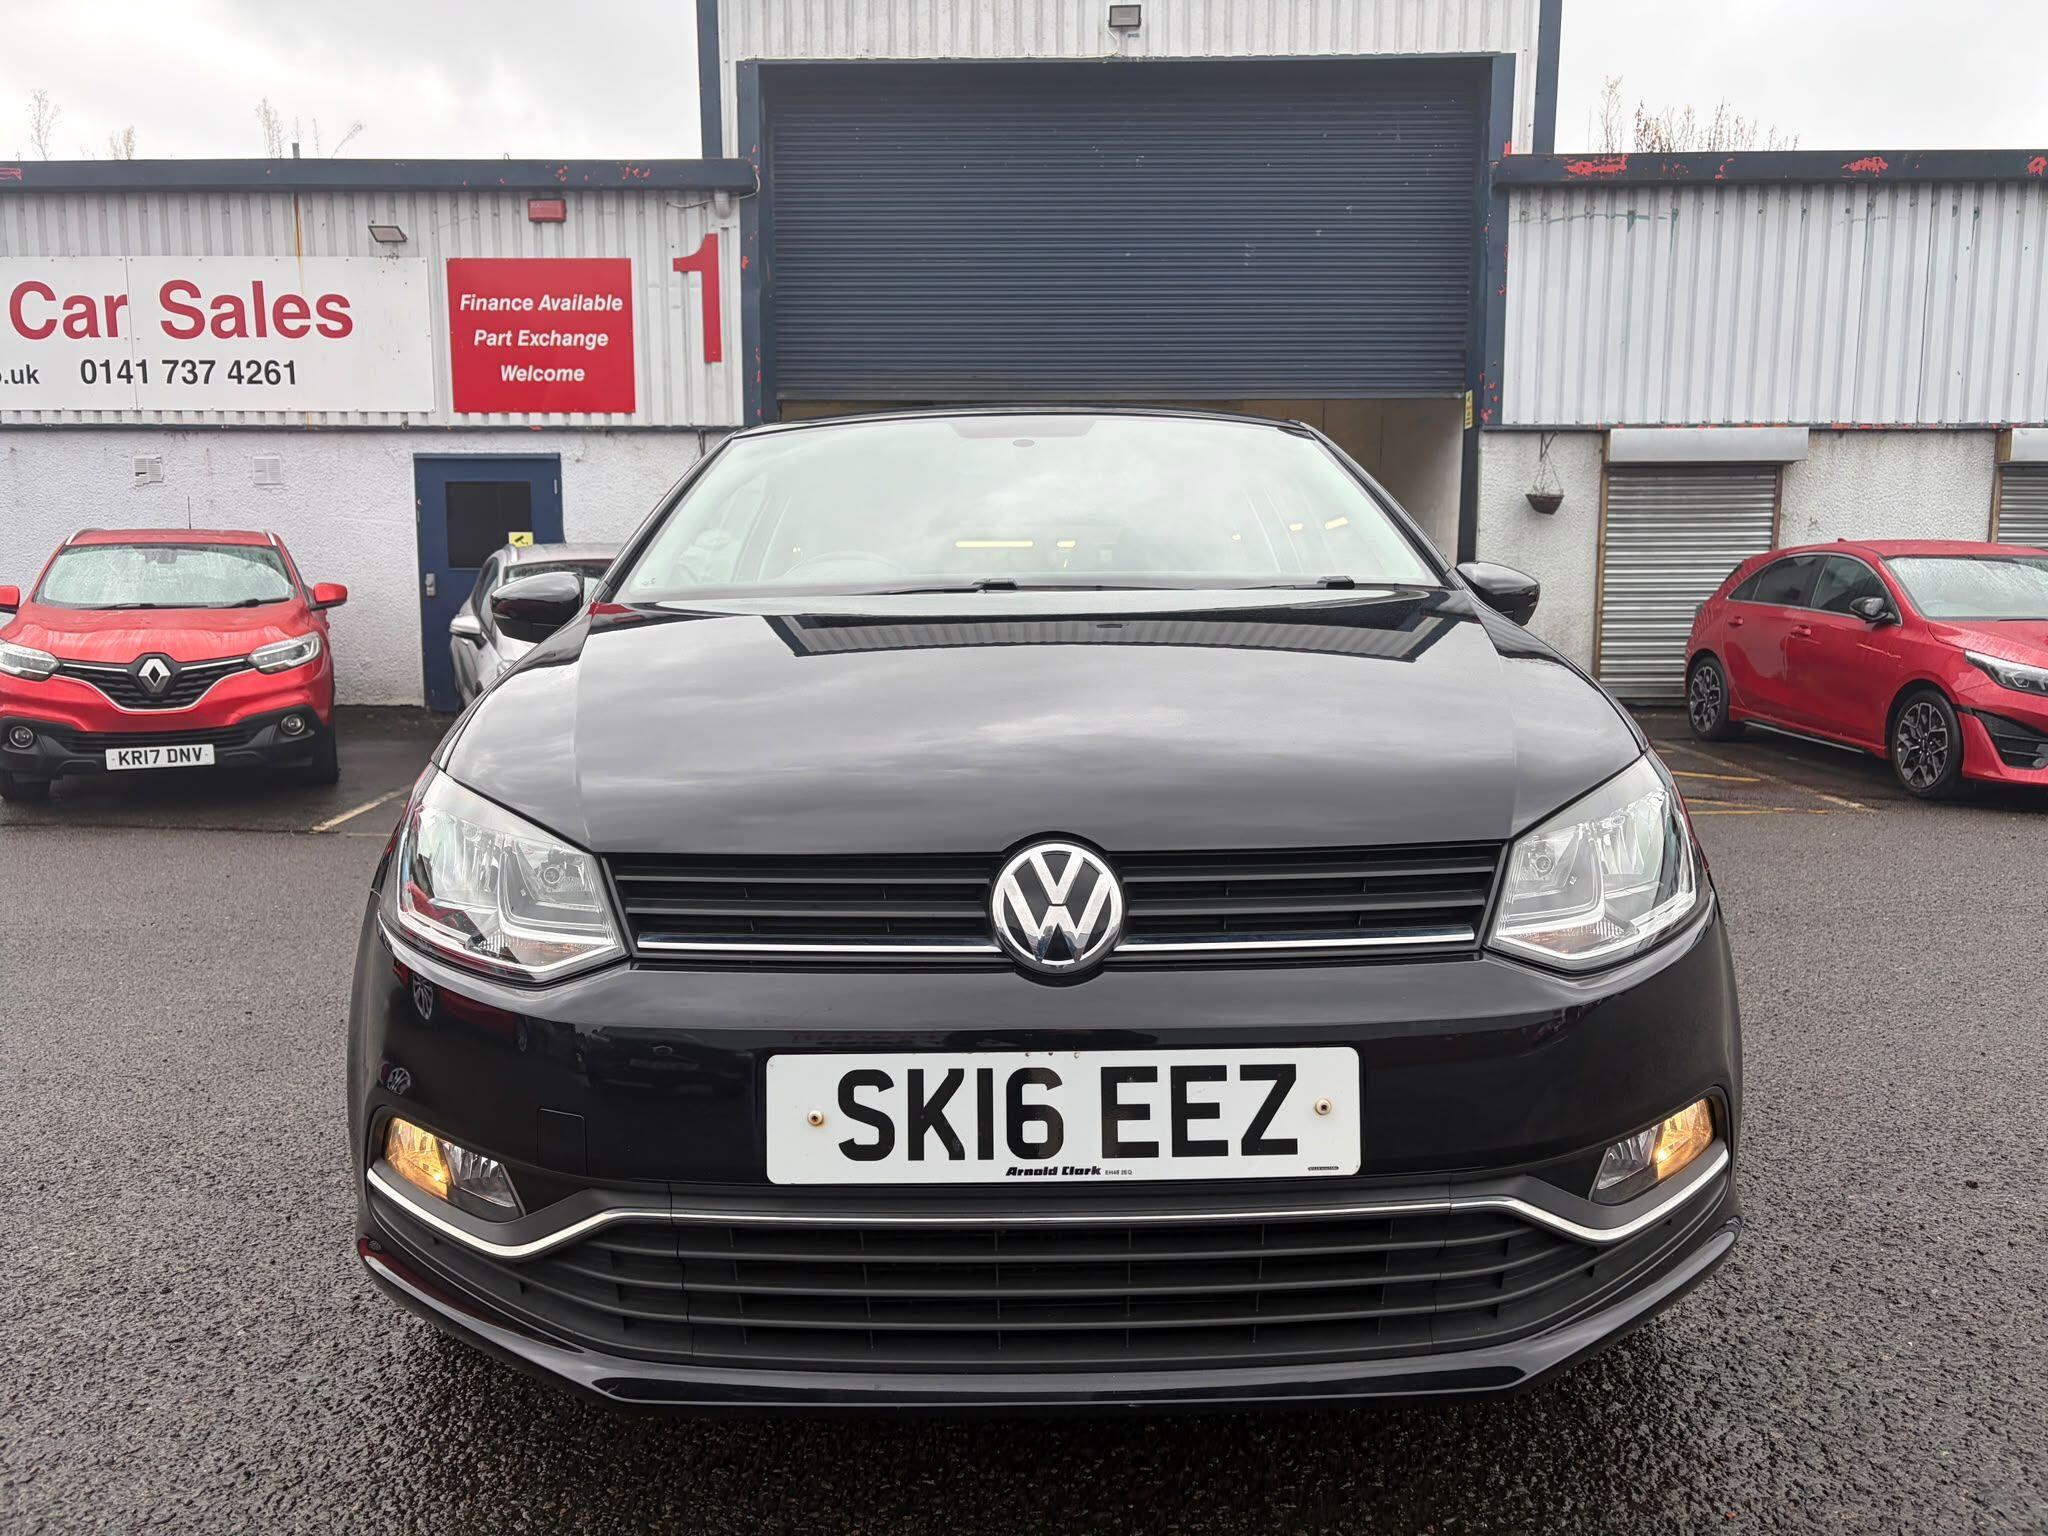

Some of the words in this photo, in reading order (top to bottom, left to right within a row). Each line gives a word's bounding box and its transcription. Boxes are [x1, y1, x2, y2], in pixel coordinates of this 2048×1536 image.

[459, 293, 534, 312] Finance
[537, 294, 623, 312] Available
[672, 232, 723, 364] 1
[9, 280, 128, 340] Car
[159, 279, 353, 340] Sales
[473, 329, 512, 347] Part
[517, 329, 609, 351] Exchange
[0, 364, 40, 384] .uk
[80, 359, 148, 385] 0141
[161, 359, 216, 385] 737
[227, 359, 296, 385] 4261
[500, 364, 585, 382] Welcome
[118, 749, 160, 766] KR17
[166, 746, 203, 763] DNV
[837, 1067, 1065, 1161] SK16
[1100, 1063, 1299, 1159] EEZ
[1005, 1166, 1058, 1176] Arnold
[1061, 1165, 1101, 1176] Clark
